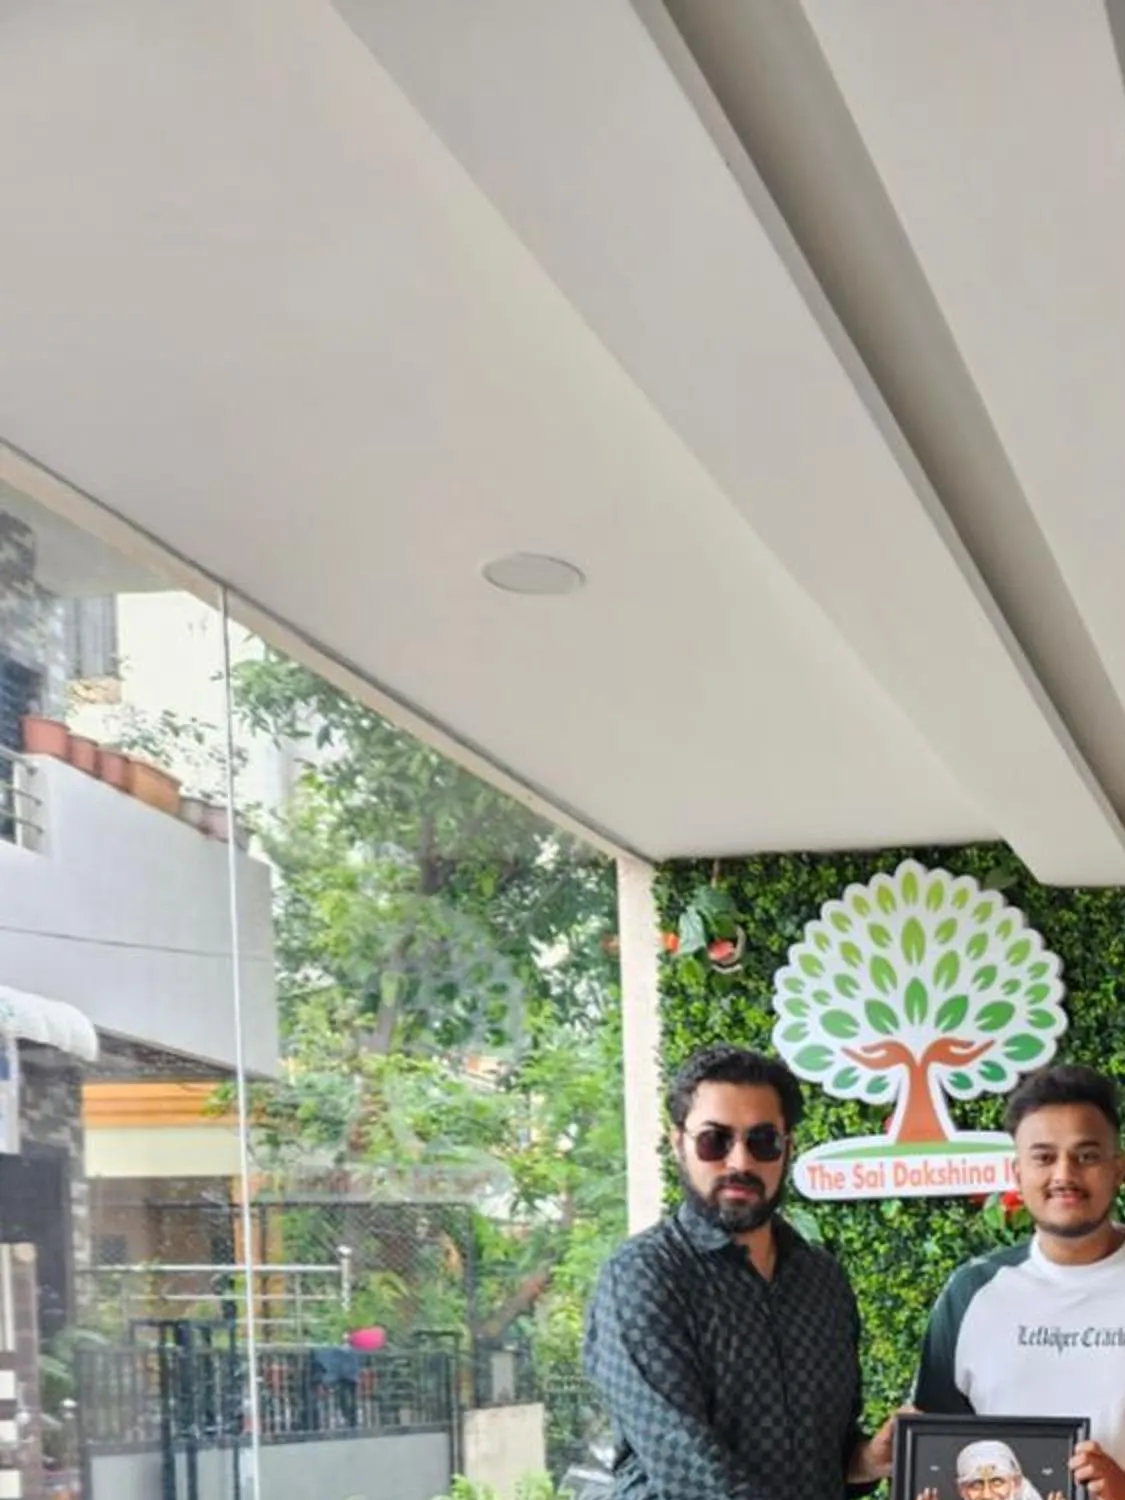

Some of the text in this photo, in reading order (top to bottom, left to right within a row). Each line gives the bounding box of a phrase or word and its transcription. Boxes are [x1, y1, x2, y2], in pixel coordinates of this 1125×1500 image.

[806, 1164, 846, 1191] The
[852, 1162, 884, 1189] Sai
[892, 1158, 995, 1189] Dakshina
